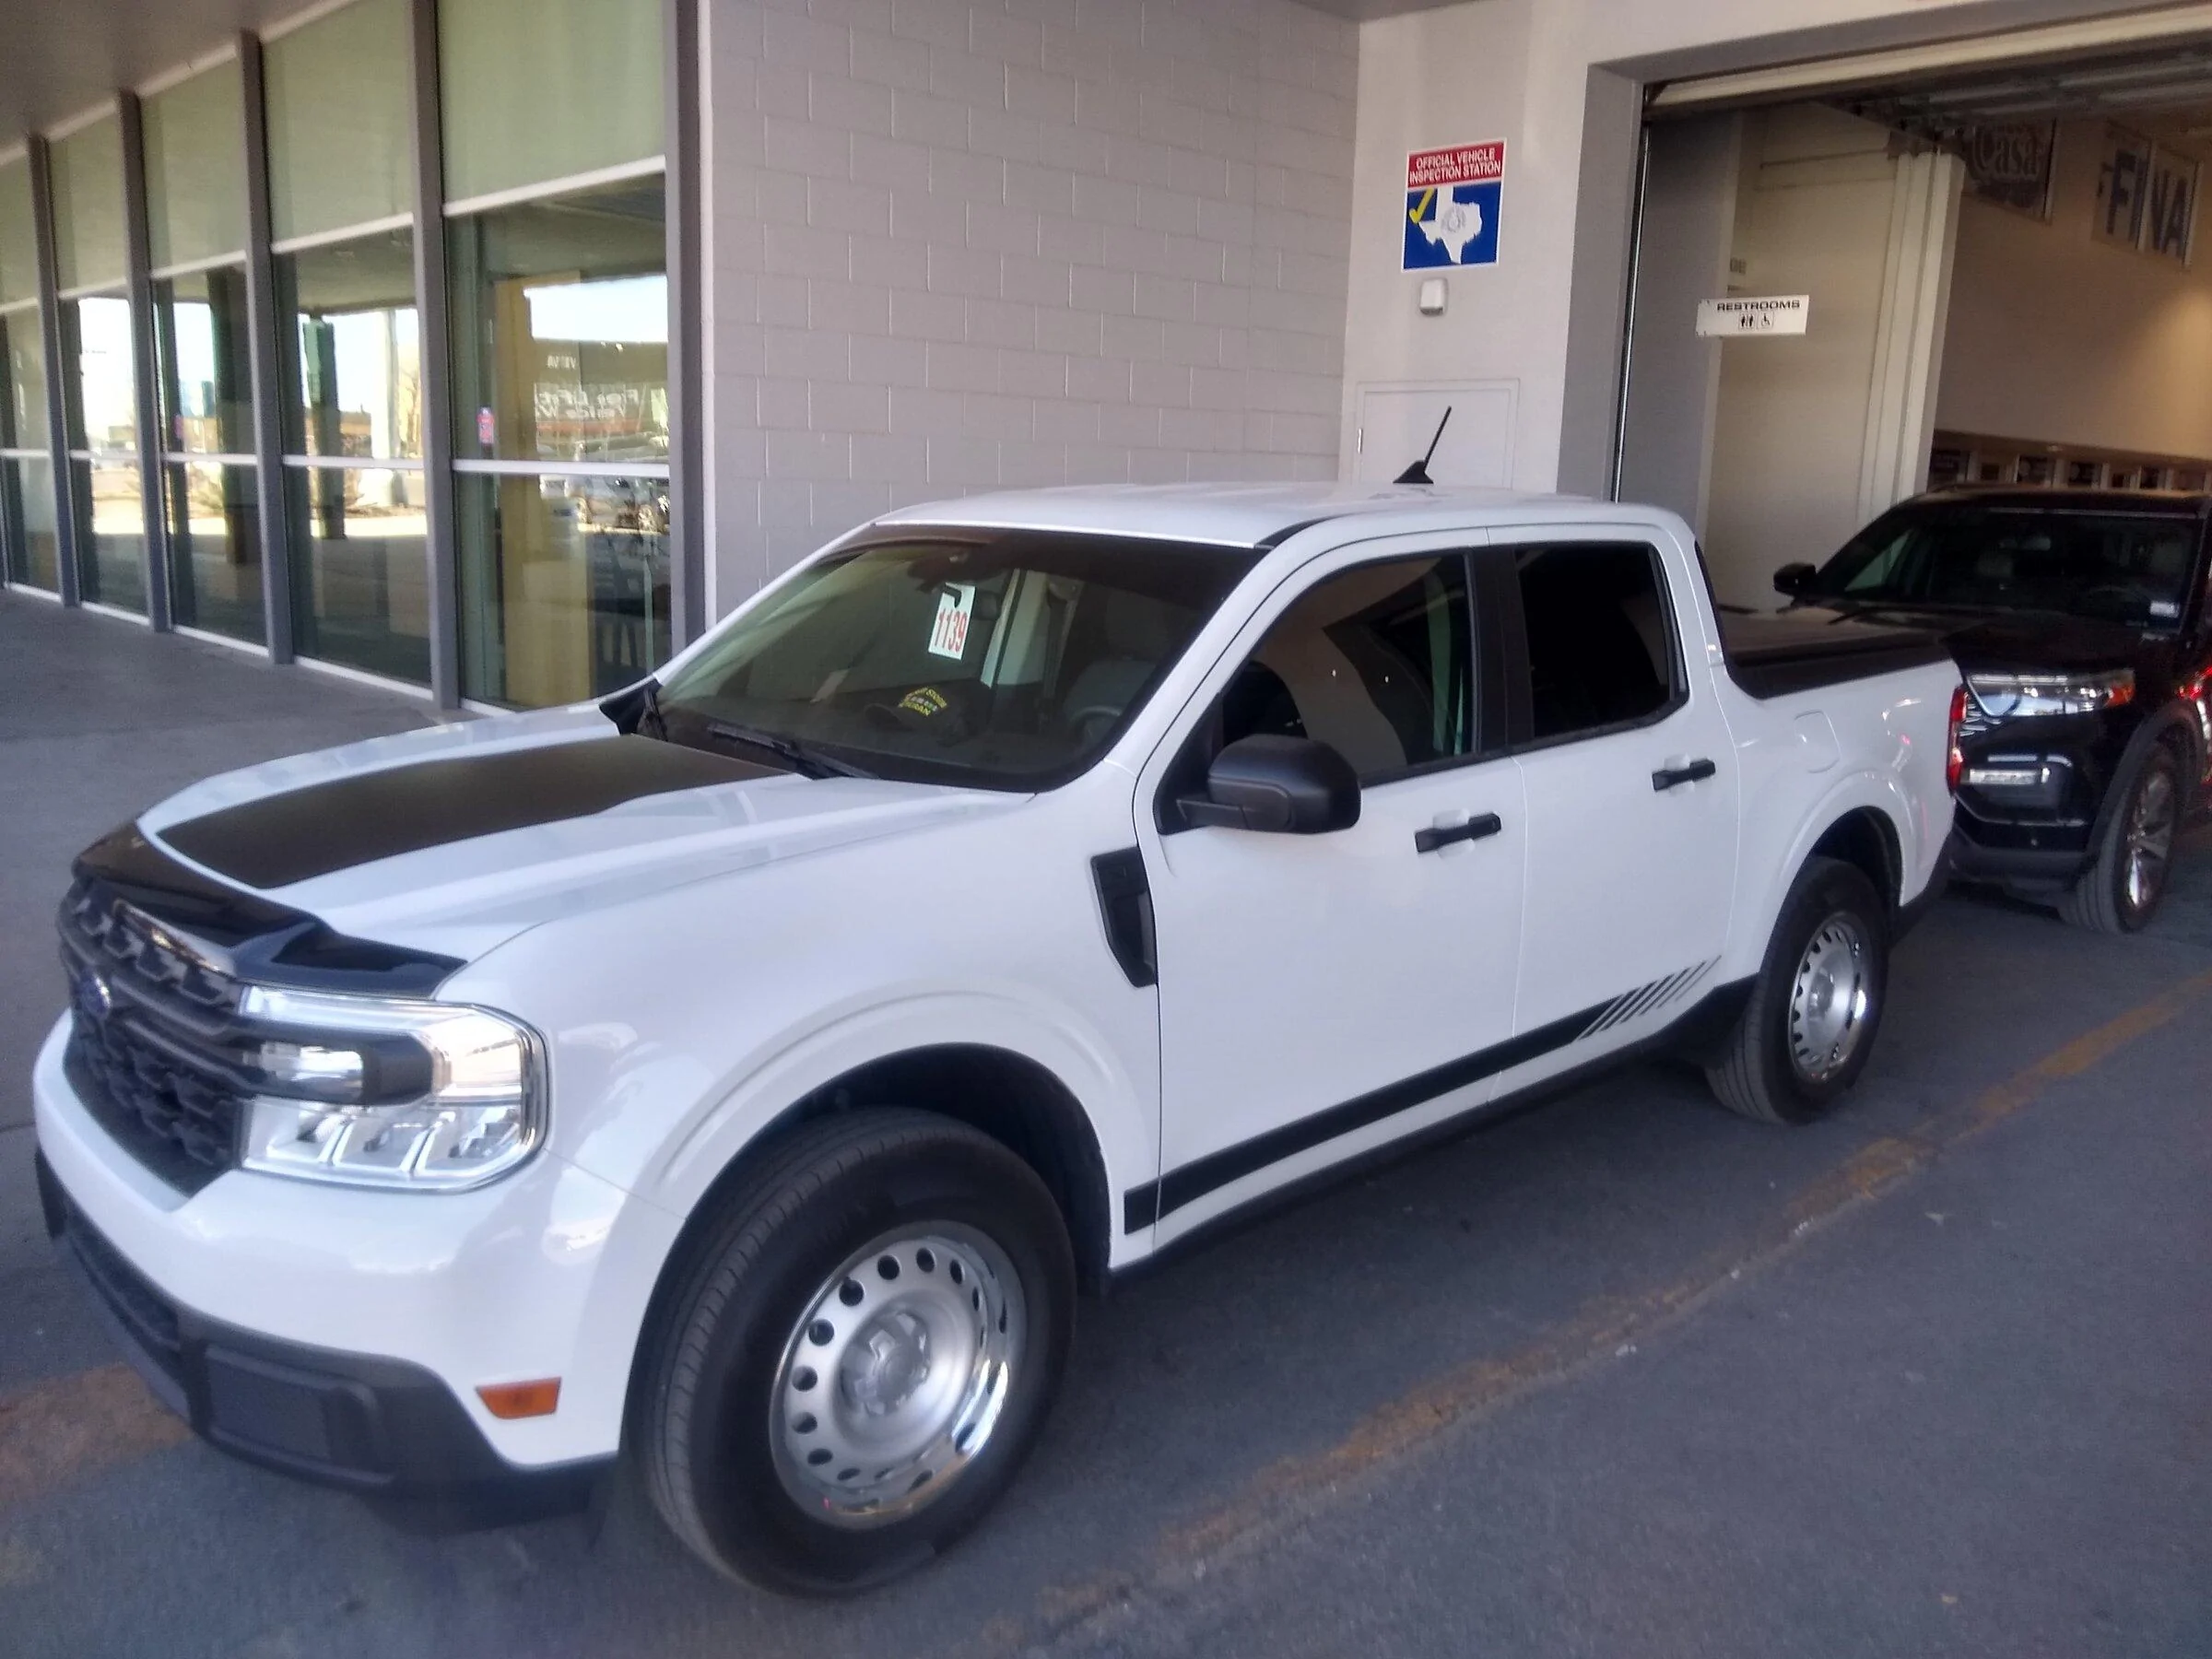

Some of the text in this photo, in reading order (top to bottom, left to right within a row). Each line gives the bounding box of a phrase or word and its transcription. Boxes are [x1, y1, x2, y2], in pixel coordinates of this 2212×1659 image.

[1416, 147, 1495, 171] OFFICIAL VEHICLE
[1409, 159, 1501, 184] INSPECTION STATION
[1716, 300, 1801, 312] RESTROOMS
[934, 607, 969, 653] 1139
